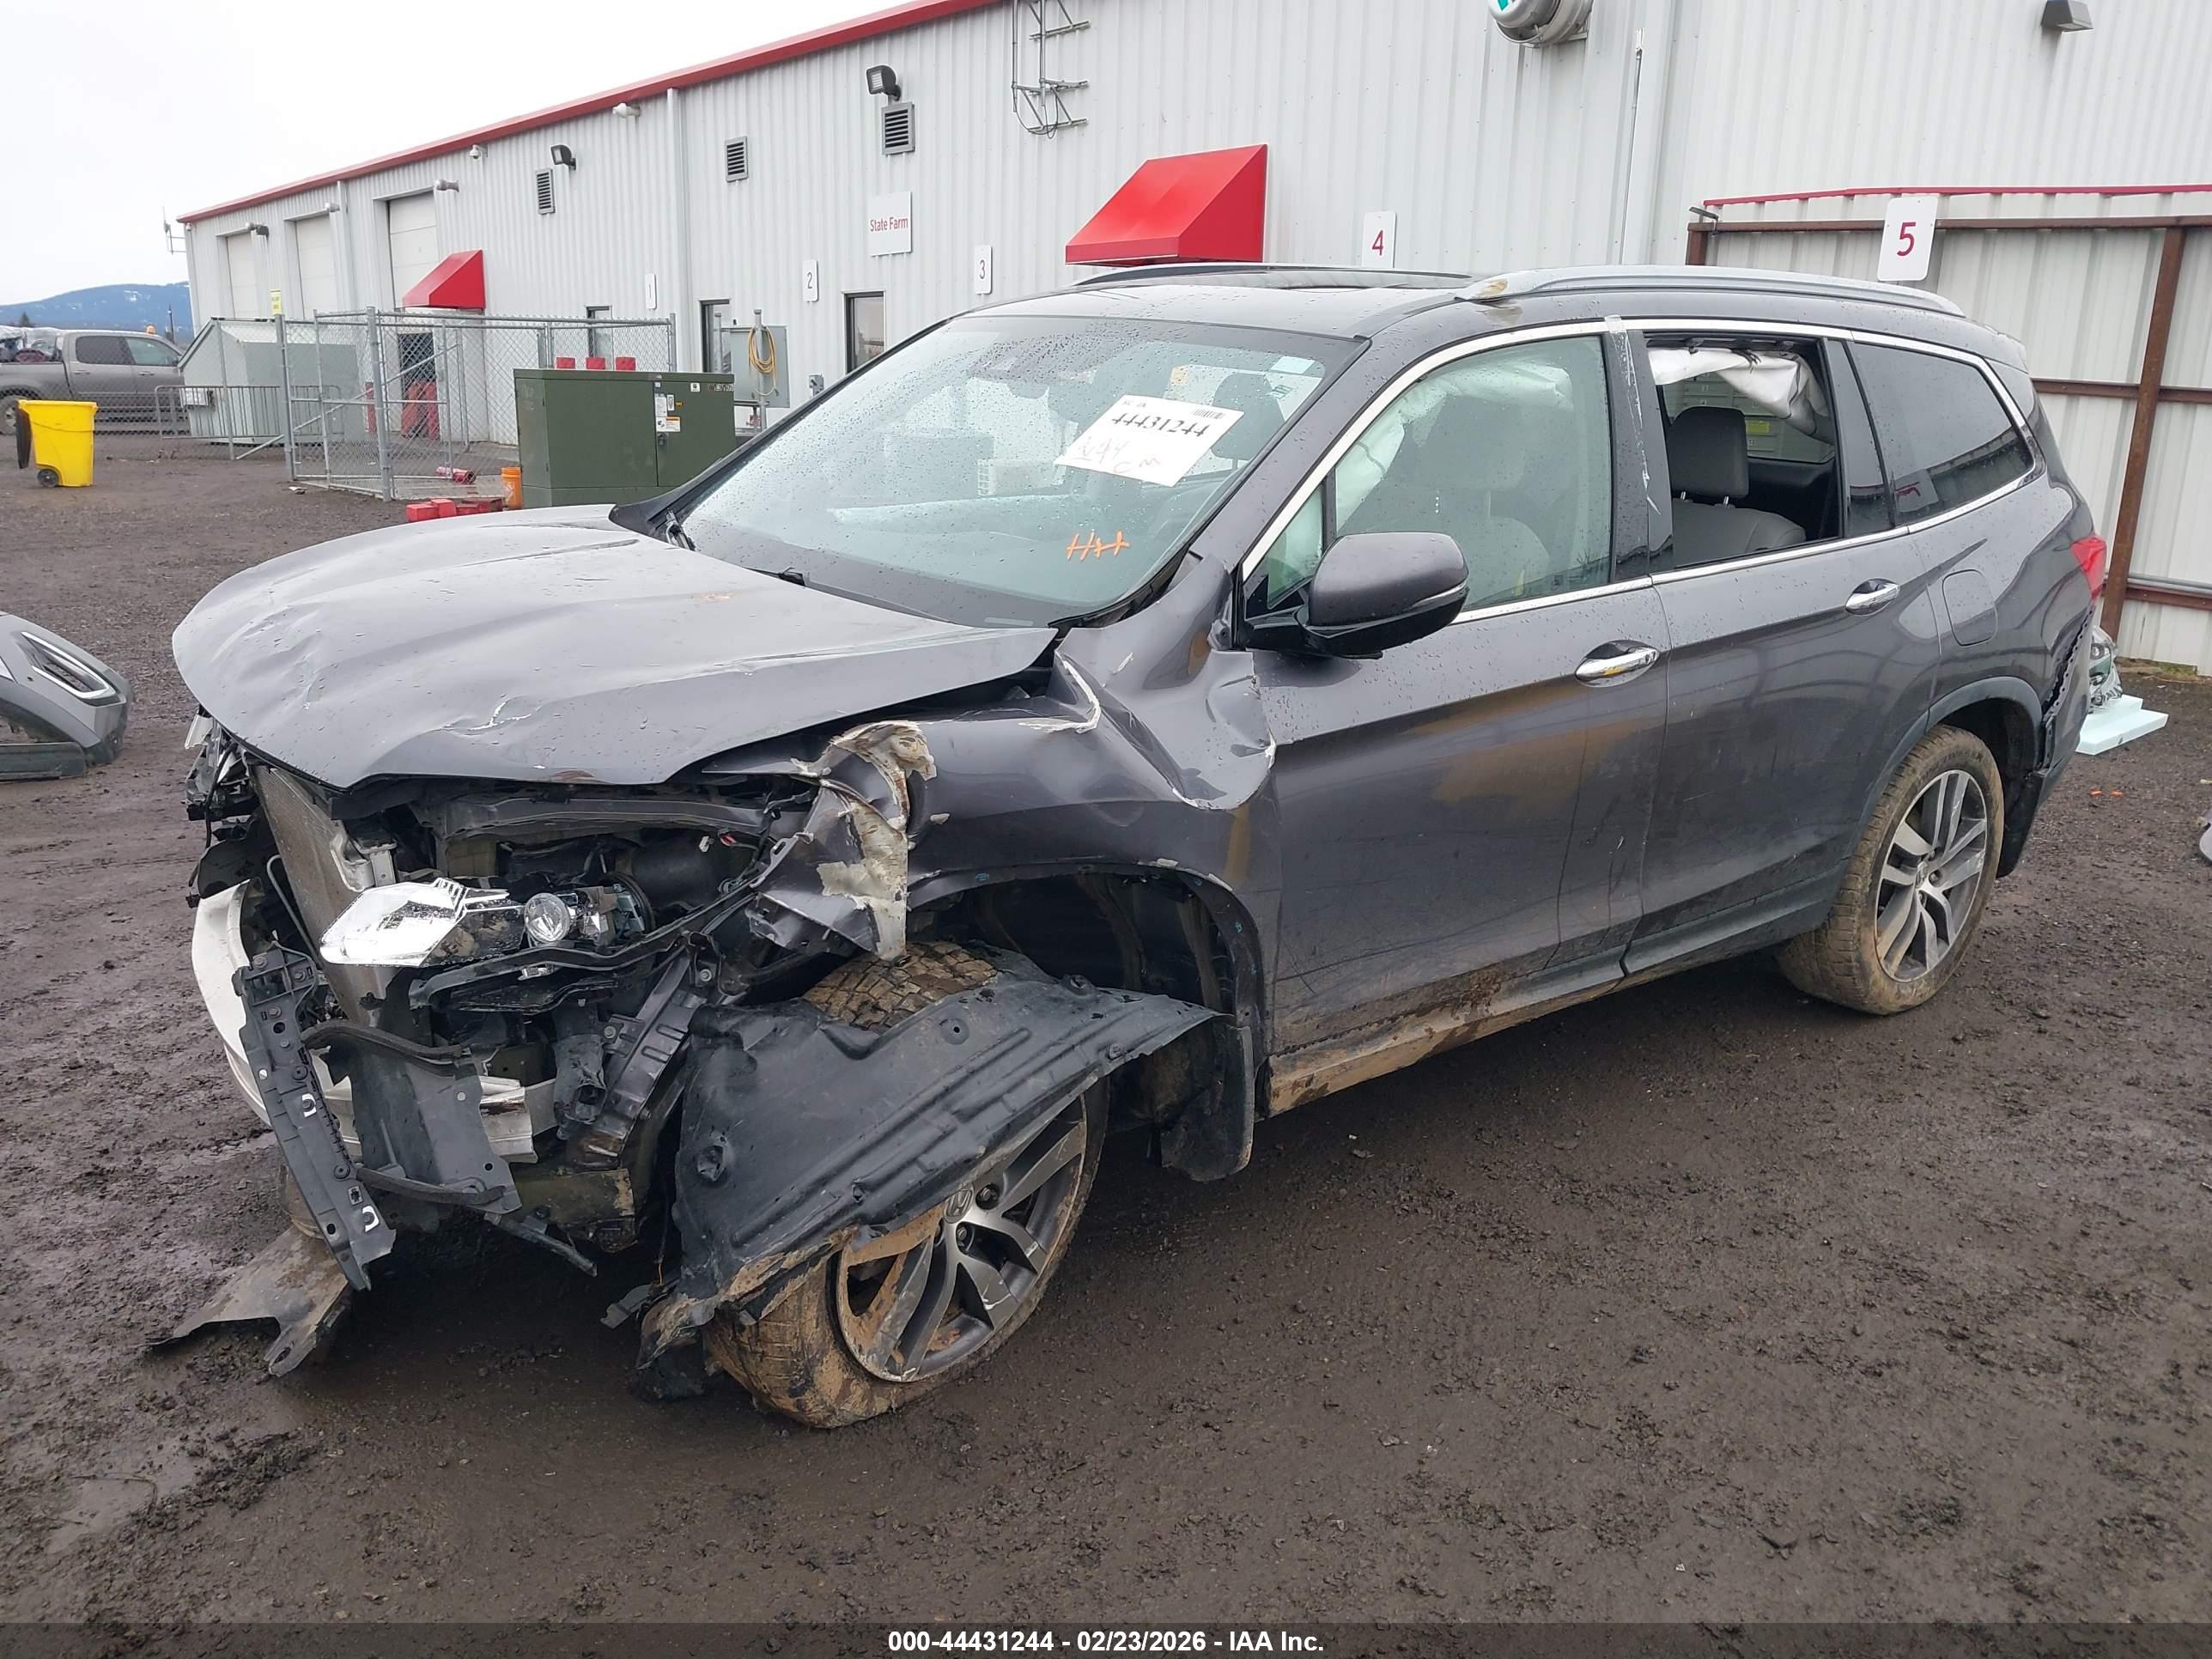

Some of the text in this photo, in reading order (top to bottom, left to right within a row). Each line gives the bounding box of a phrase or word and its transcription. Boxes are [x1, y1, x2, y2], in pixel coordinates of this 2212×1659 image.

[870, 216, 908, 232] State Farm
[1371, 229, 1384, 256] 4
[1896, 222, 1917, 257] 5
[806, 271, 813, 289] 2
[979, 259, 986, 280] 3
[1111, 412, 1211, 437] 44431244
